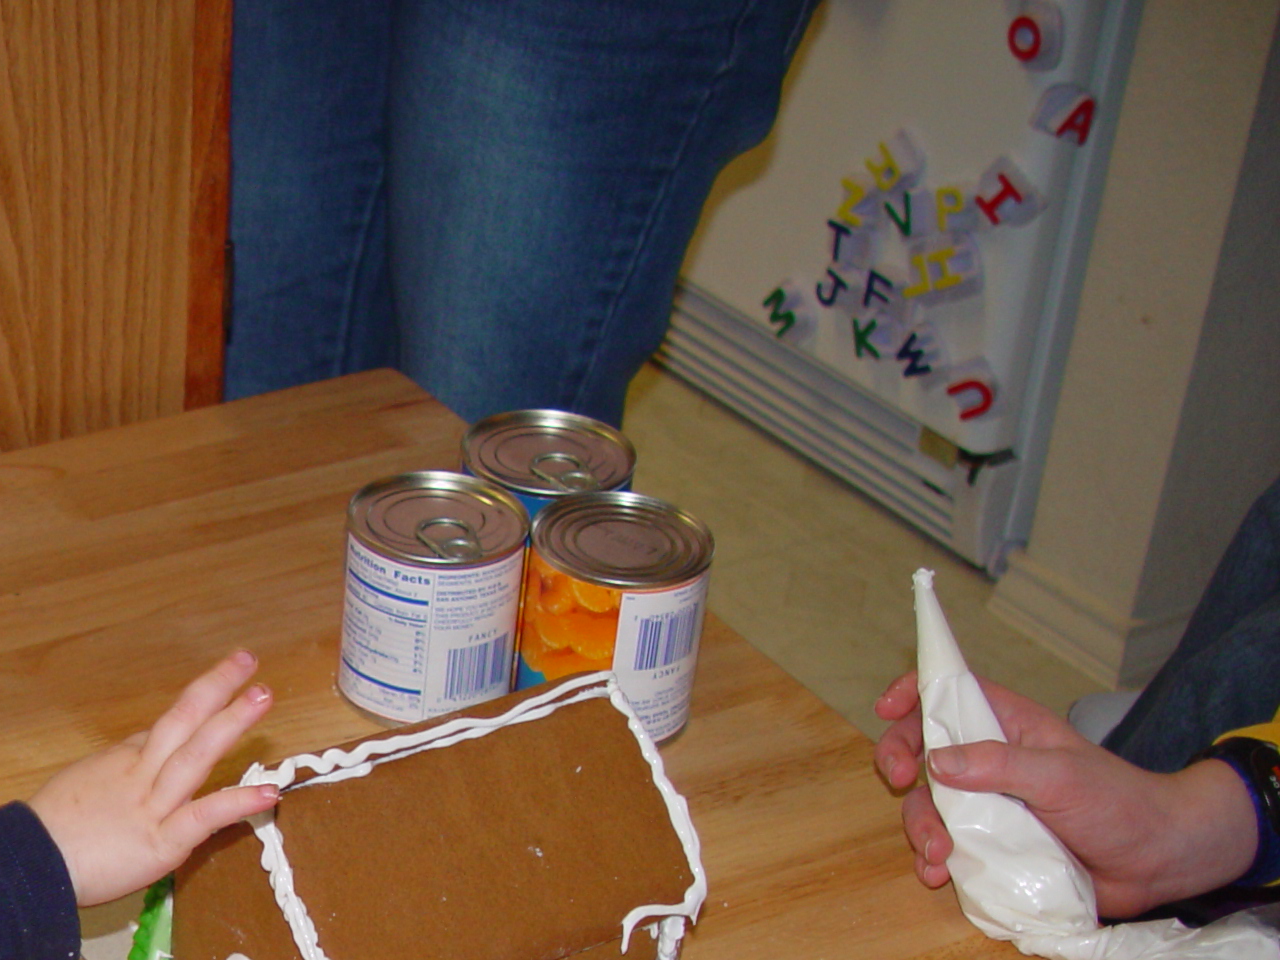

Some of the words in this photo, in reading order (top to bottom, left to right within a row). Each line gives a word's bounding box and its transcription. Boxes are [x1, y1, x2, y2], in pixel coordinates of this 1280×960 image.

[1008, 16, 1041, 62] O
[1056, 98, 1095, 145] A
[885, 191, 910, 236] V
[936, 187, 963, 232] P
[828, 219, 852, 261] T
[816, 268, 848, 306] J
[864, 270, 893, 306] F
[853, 318, 880, 358] K
[946, 380, 992, 420] U
[393, 570, 431, 585] Facts
[468, 629, 497, 643] FANCY
[653, 666, 680, 680] FANCY
